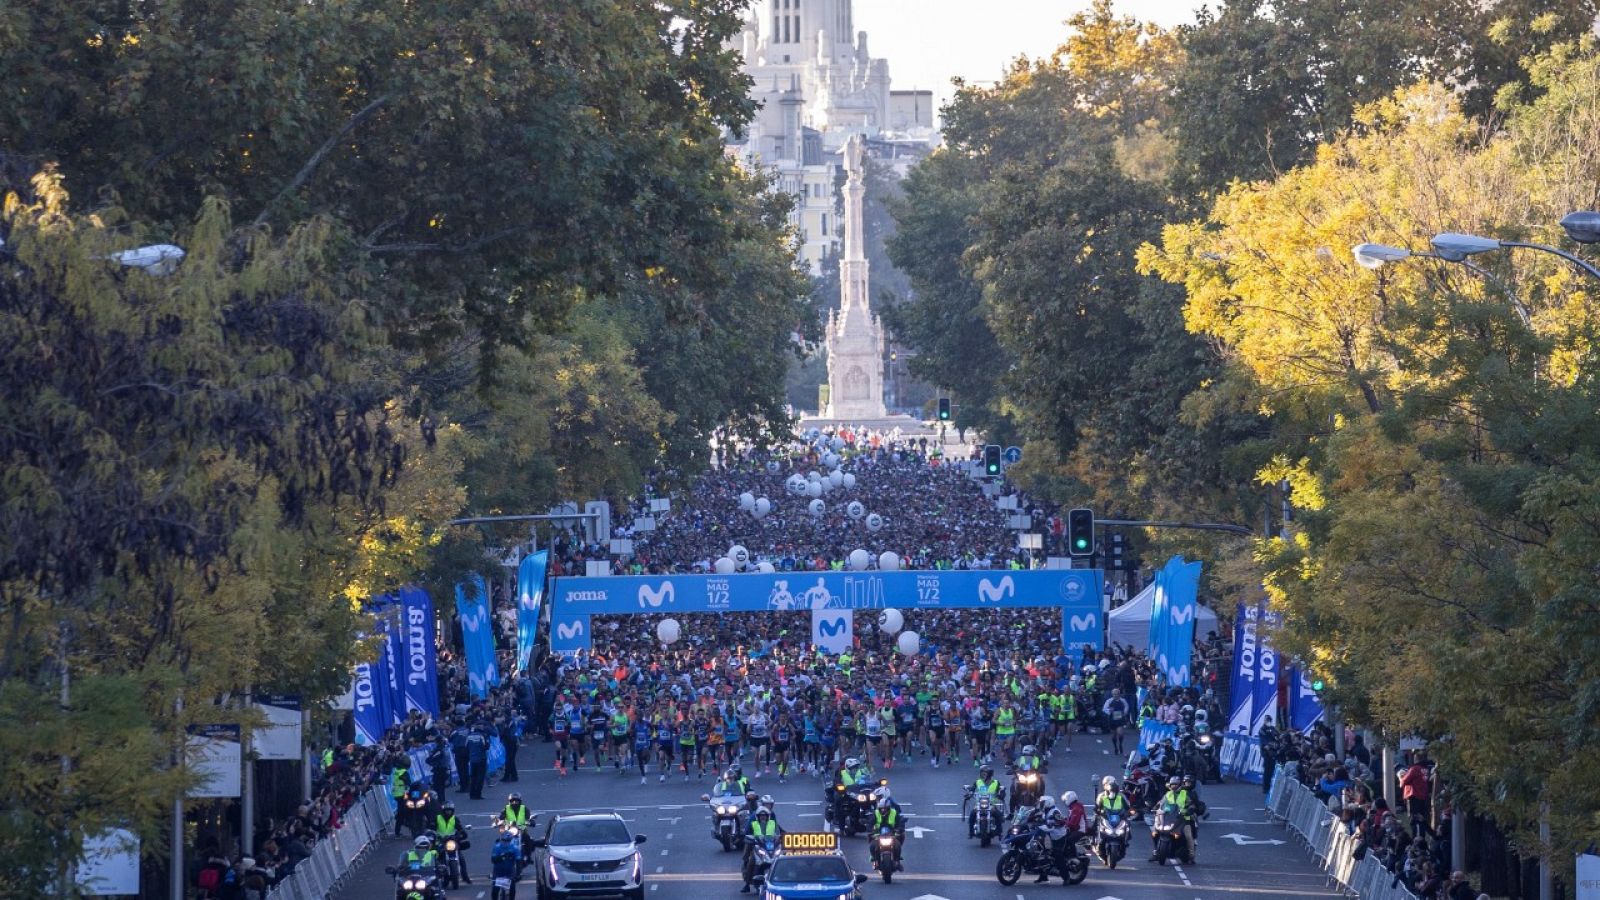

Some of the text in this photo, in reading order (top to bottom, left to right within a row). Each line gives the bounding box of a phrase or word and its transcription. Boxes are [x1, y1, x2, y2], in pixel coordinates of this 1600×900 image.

[707, 583, 730, 591] MAD
[707, 591, 730, 604] 1/2
[917, 588, 940, 600] 1/2
